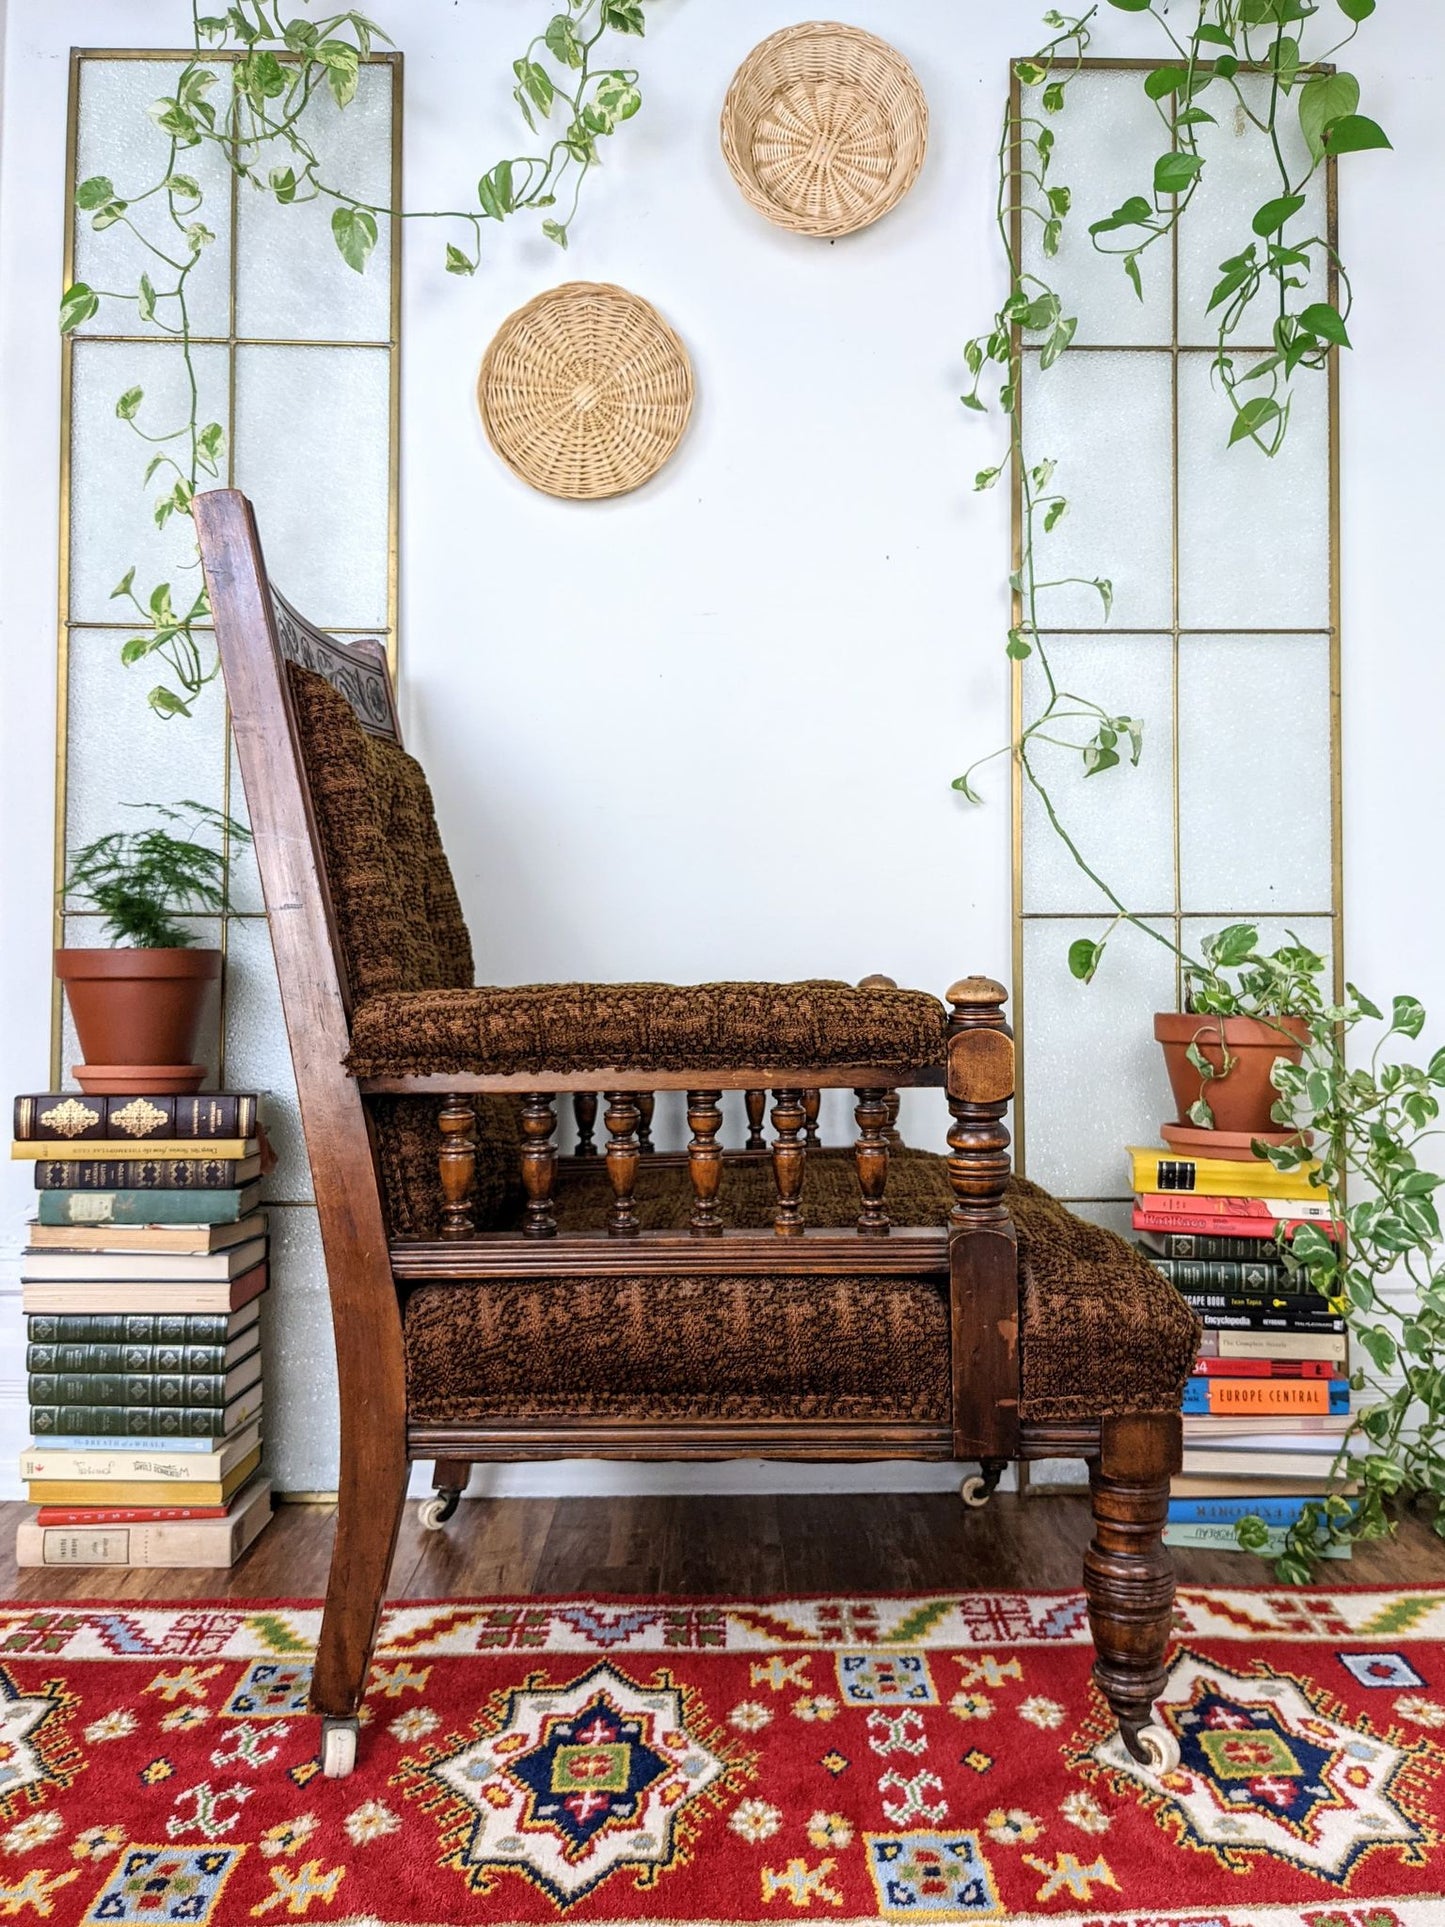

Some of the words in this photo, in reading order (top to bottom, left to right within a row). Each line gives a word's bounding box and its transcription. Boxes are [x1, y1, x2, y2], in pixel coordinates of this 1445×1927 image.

[84, 1169, 92, 1182] THE
[1206, 1296, 1225, 1307] BOOK
[1204, 1315, 1251, 1326] Encyclopedia
[1223, 1339, 1234, 1347] The
[1236, 1340, 1263, 1348] Complete
[1220, 1388, 1262, 1402] EUROPE
[1268, 1390, 1320, 1403] CENTRAL
[85, 1439, 120, 1447] BREATH
[134, 1440, 166, 1448] WHALE
[68, 1510, 135, 1521] FIRST
[153, 1509, 191, 1517] AID
[1196, 1506, 1282, 1519] EXPLORER
